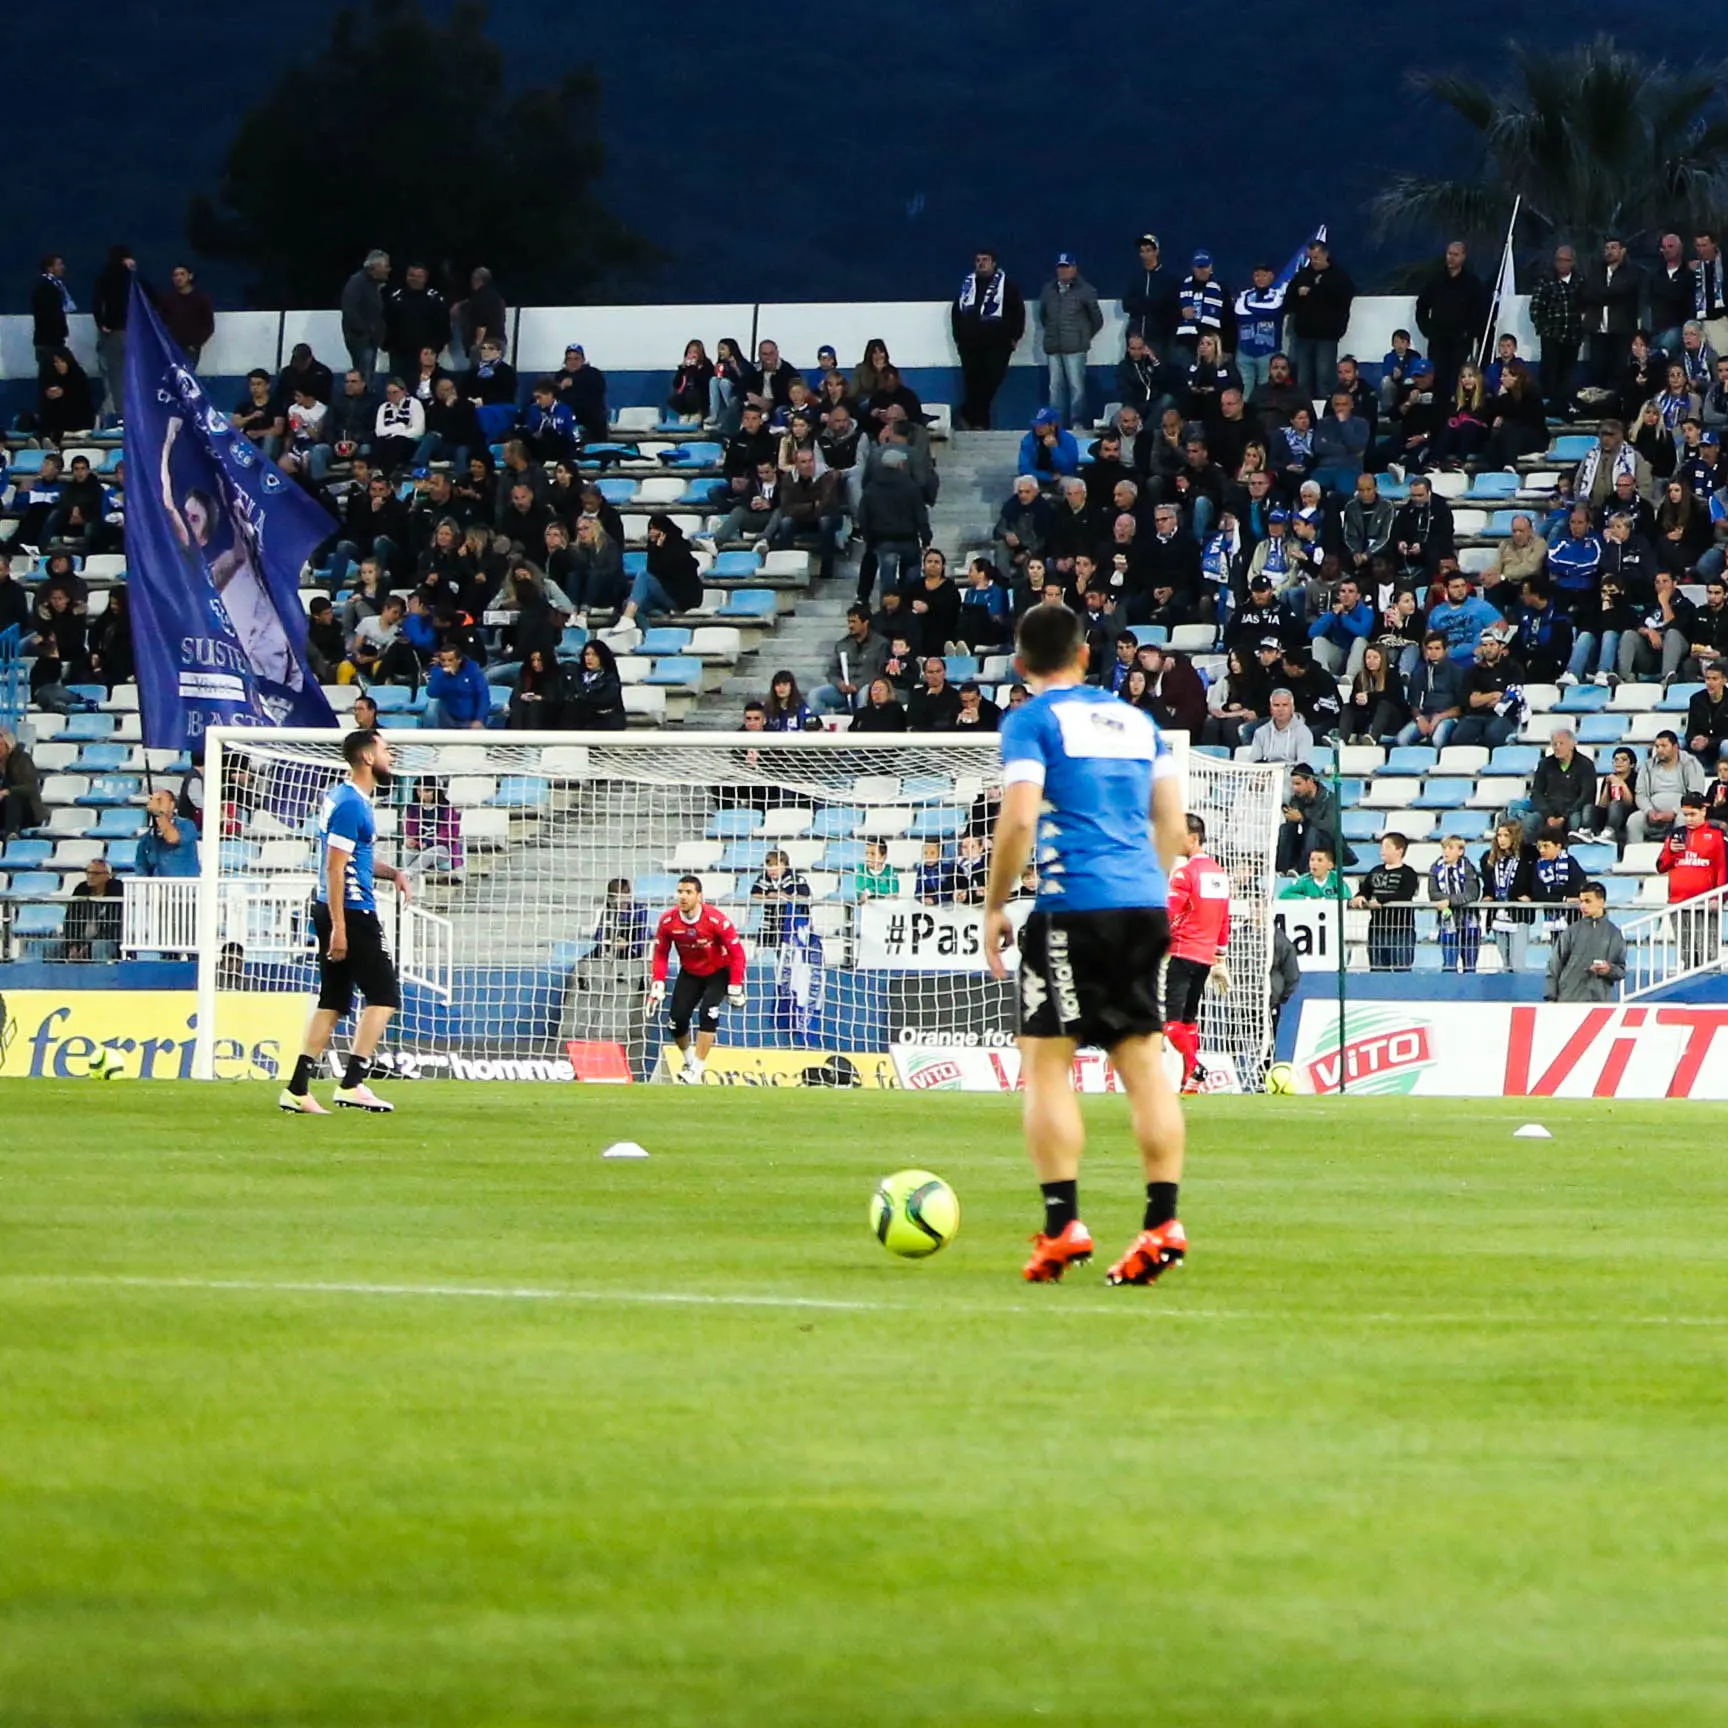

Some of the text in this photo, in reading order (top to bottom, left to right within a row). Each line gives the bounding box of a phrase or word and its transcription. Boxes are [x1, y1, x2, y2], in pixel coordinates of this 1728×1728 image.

[28, 1007, 281, 1079] ferries
[899, 1026, 979, 1047] Orange
[451, 1051, 576, 1081] homme
